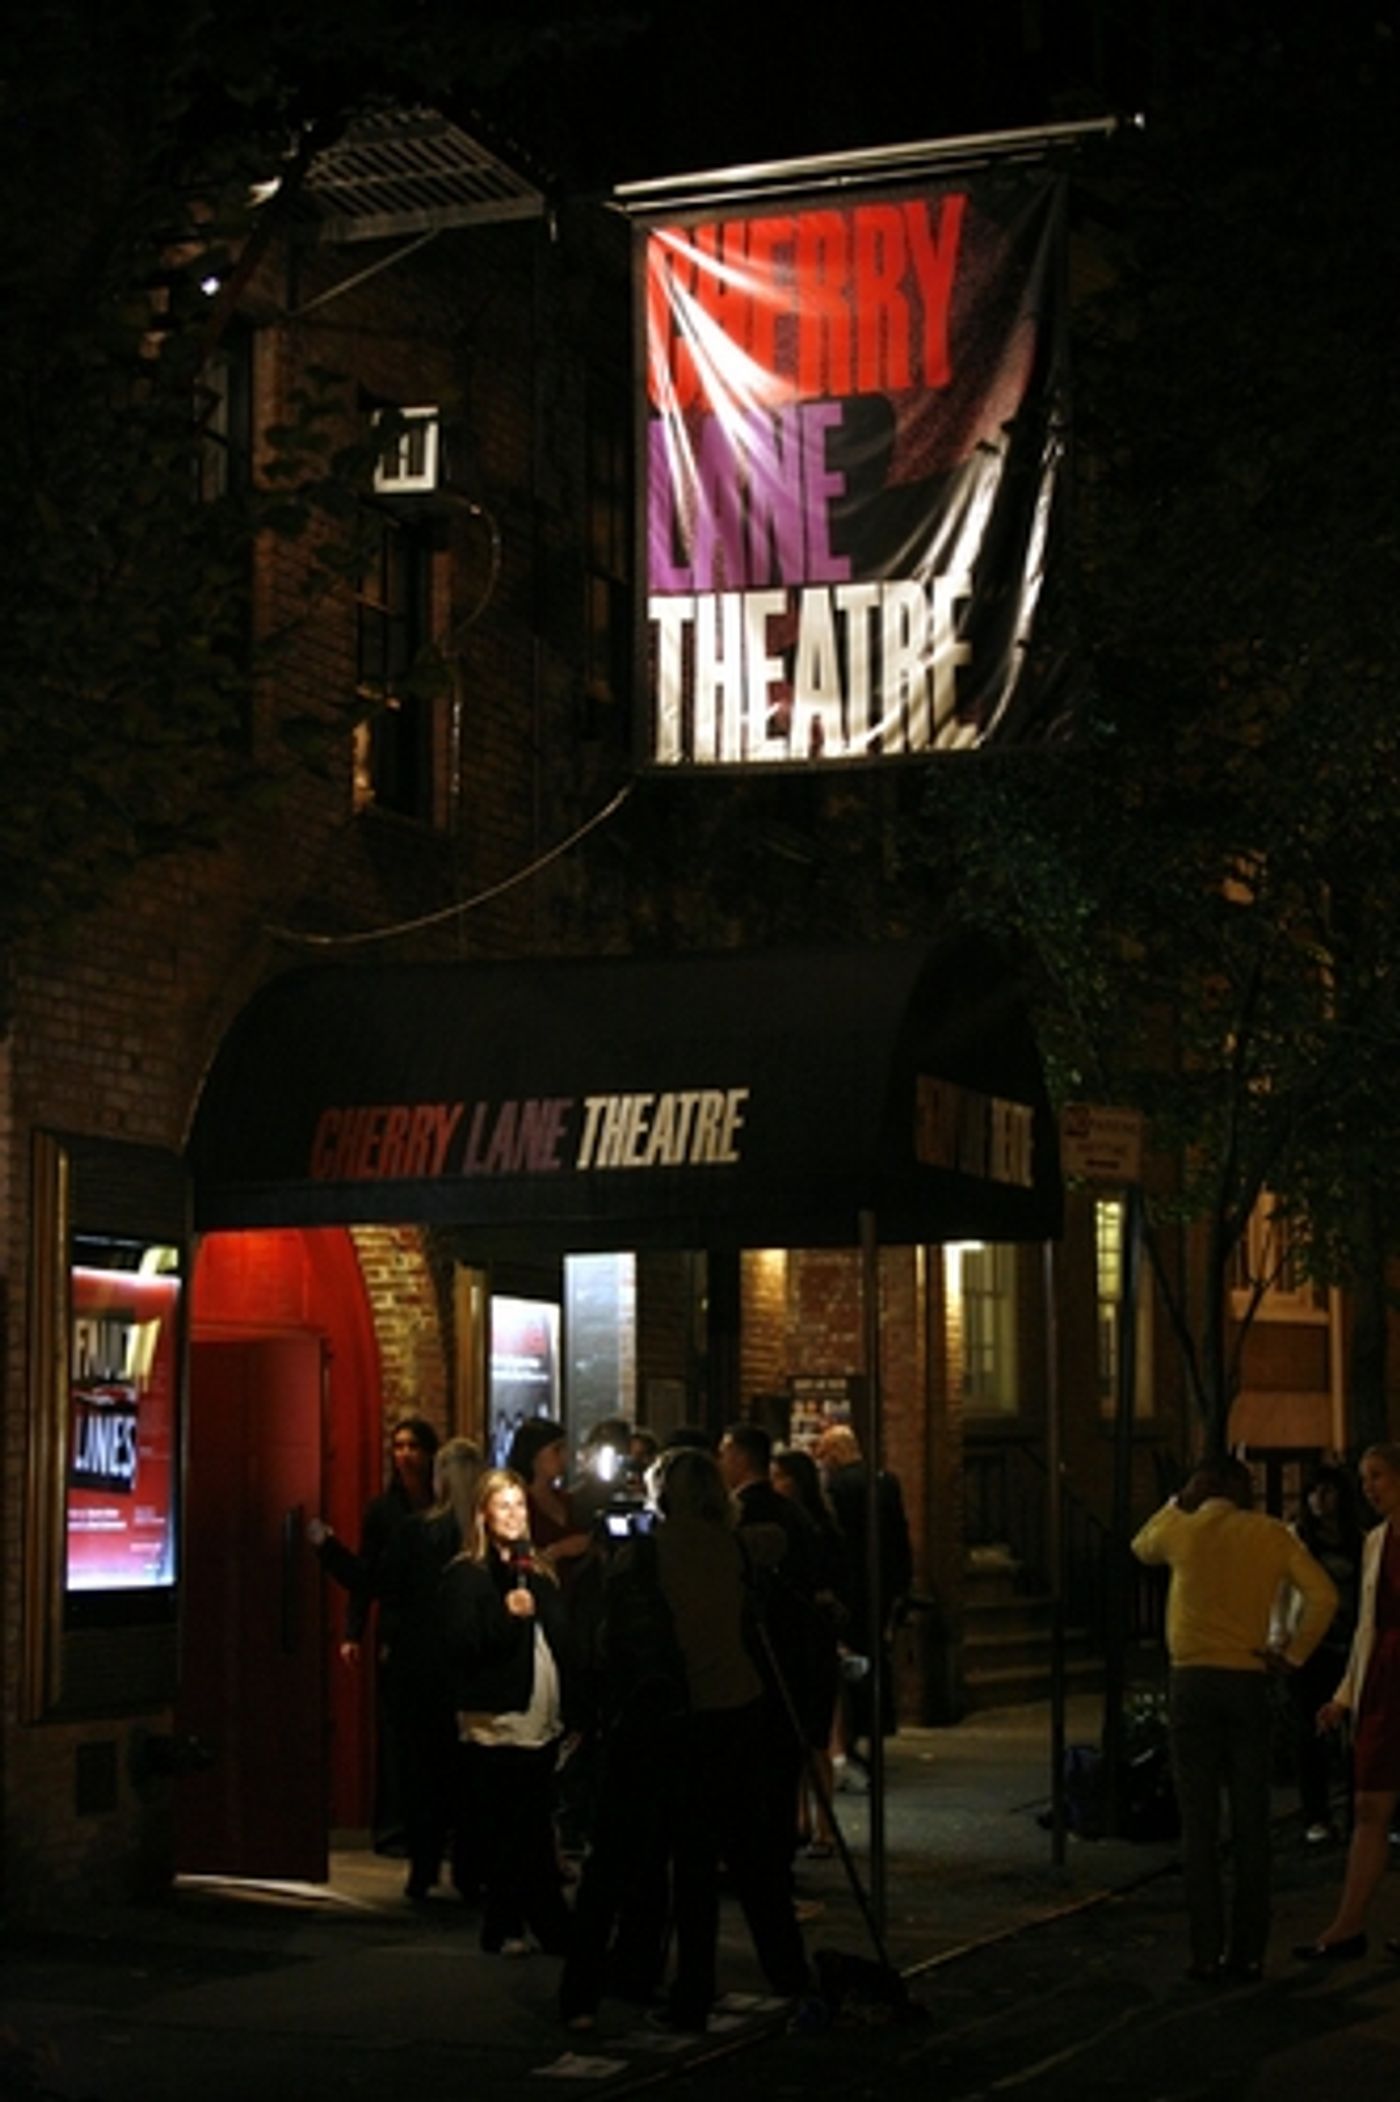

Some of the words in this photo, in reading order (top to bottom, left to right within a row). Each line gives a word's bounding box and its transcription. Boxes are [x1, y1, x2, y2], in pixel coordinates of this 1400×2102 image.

[648, 194, 968, 414] CHERRY
[648, 402, 852, 591] LANE
[648, 572, 980, 765] THEATRE
[310, 1103, 464, 1180] CHERRY
[462, 1099, 574, 1175] LANE
[575, 1088, 751, 1170] THEATRE
[74, 1413, 137, 1479] LANES
